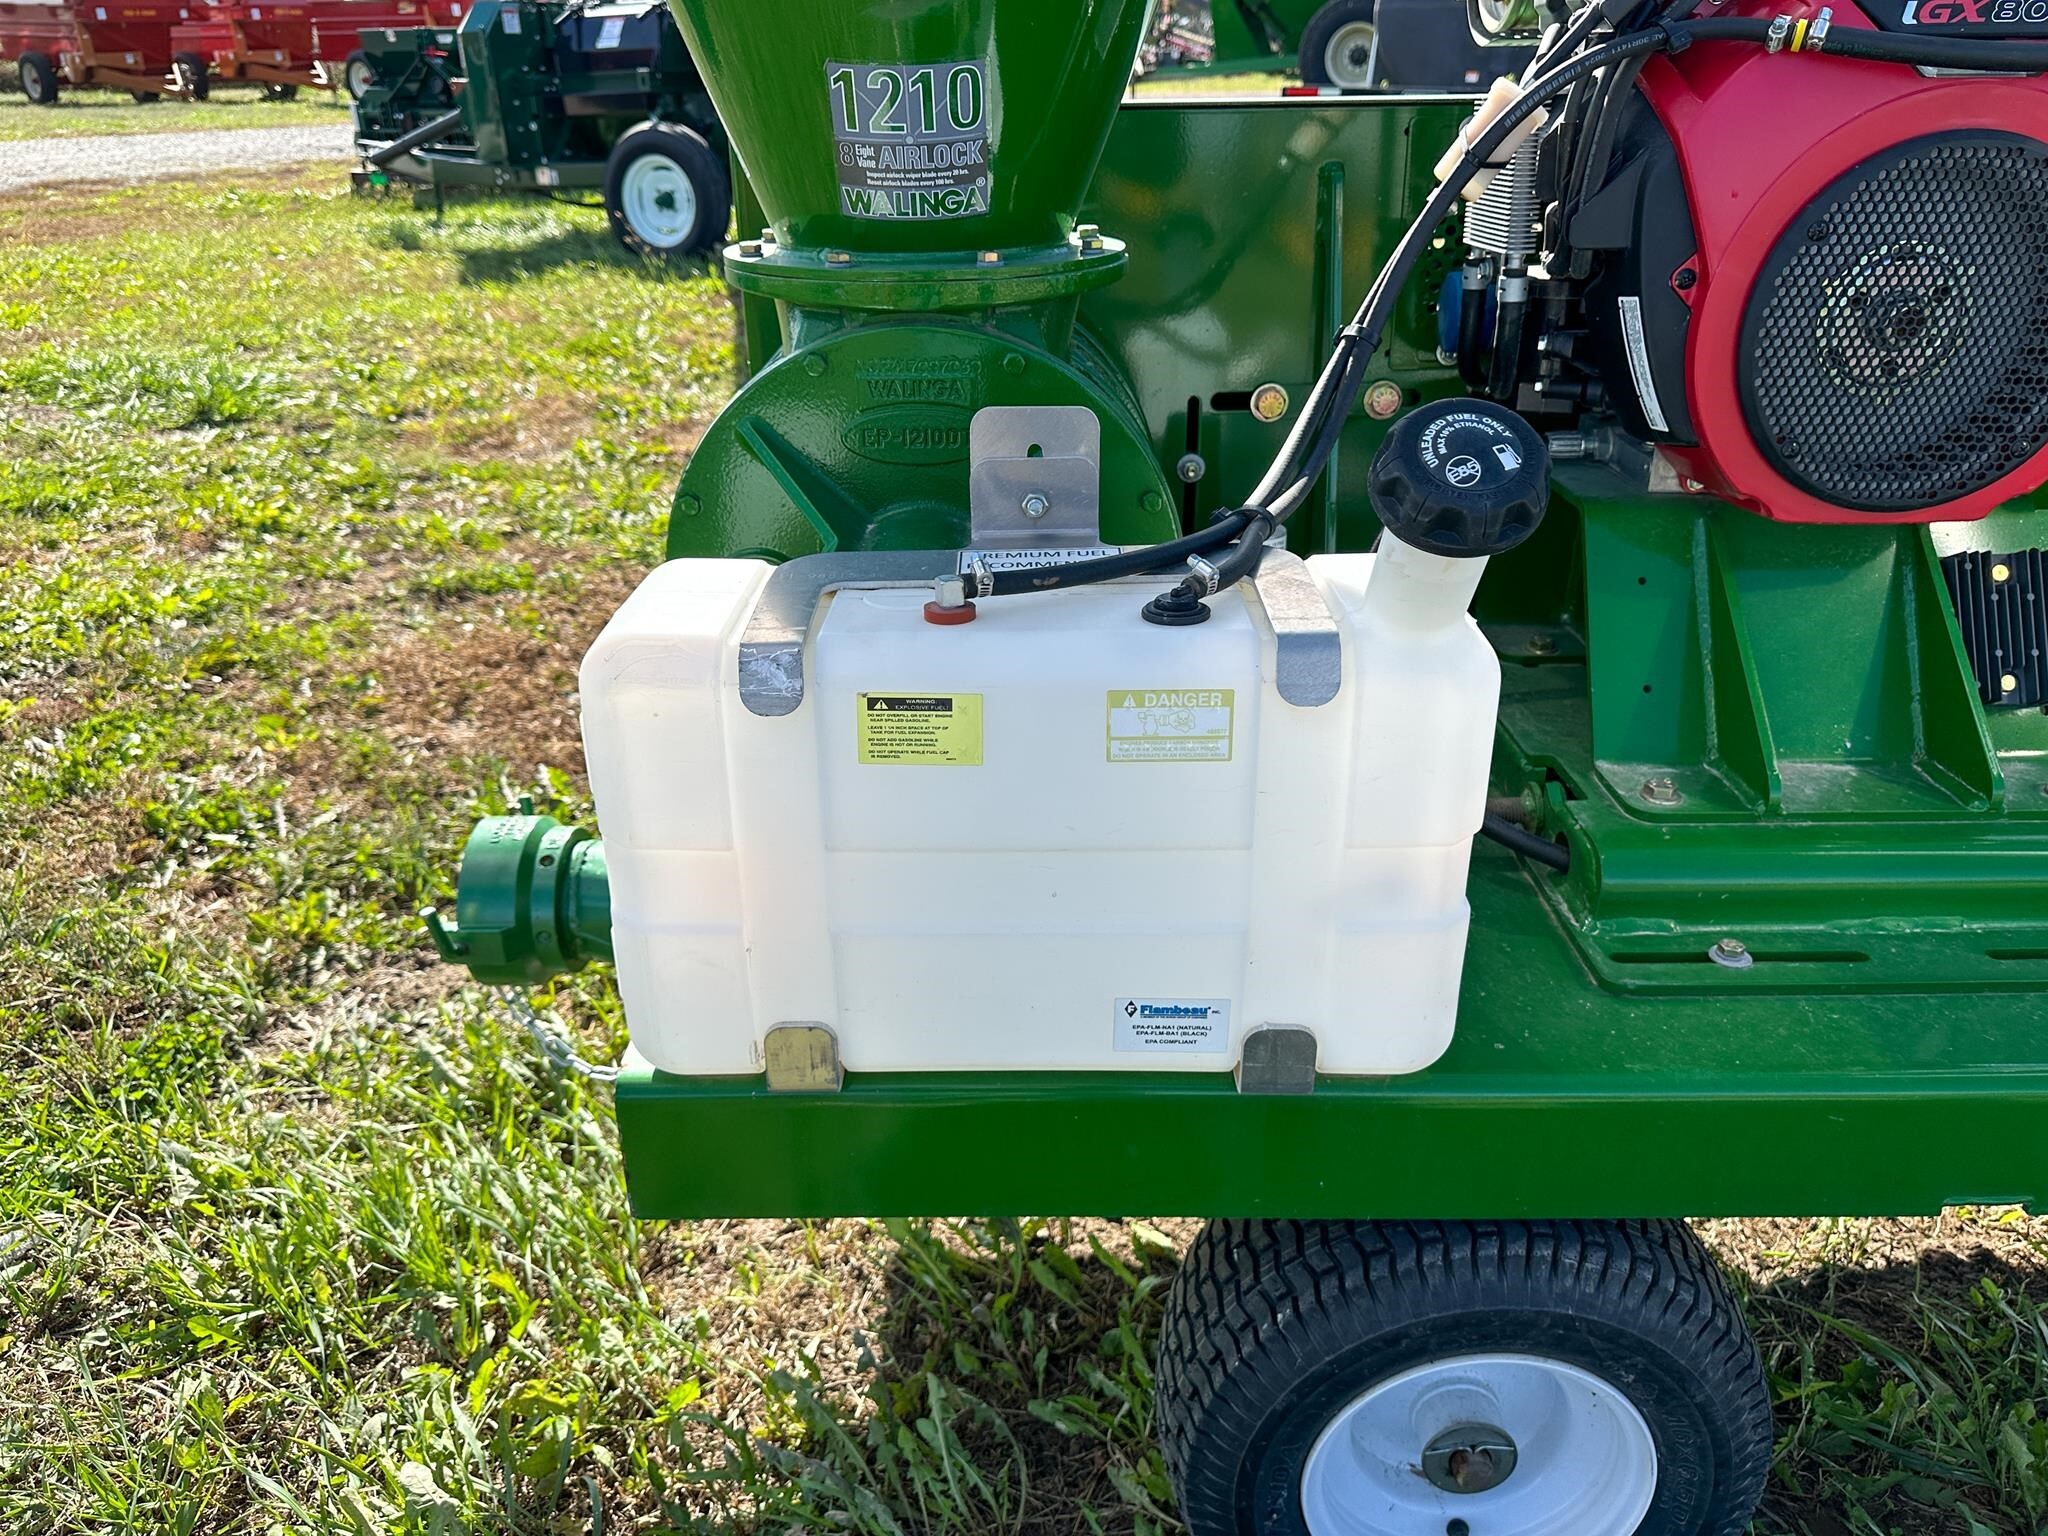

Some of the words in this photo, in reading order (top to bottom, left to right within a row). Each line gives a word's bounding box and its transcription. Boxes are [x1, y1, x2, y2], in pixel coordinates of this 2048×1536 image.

[831, 65, 983, 134] 1210
[840, 142, 854, 167] 8
[855, 143, 875, 159] Eight
[879, 140, 984, 170] AIRLOCK
[856, 156, 877, 169] Vane
[922, 170, 937, 178] blade
[938, 170, 952, 178] every
[920, 179, 935, 187] every
[842, 186, 986, 217] WALINGA
[1440, 426, 1455, 437] 10%
[1454, 421, 1495, 435] ETHANOL
[1421, 419, 1447, 468] UNLEADED
[1446, 413, 1479, 421] FUEL
[1482, 417, 1513, 437] ONLY
[1437, 438, 1447, 455] MAX
[1448, 460, 1479, 482] E85
[983, 551, 1061, 559] REMIUM
[1144, 692, 1222, 707] DANGER
[1140, 1005, 1208, 1014] Flambeau
